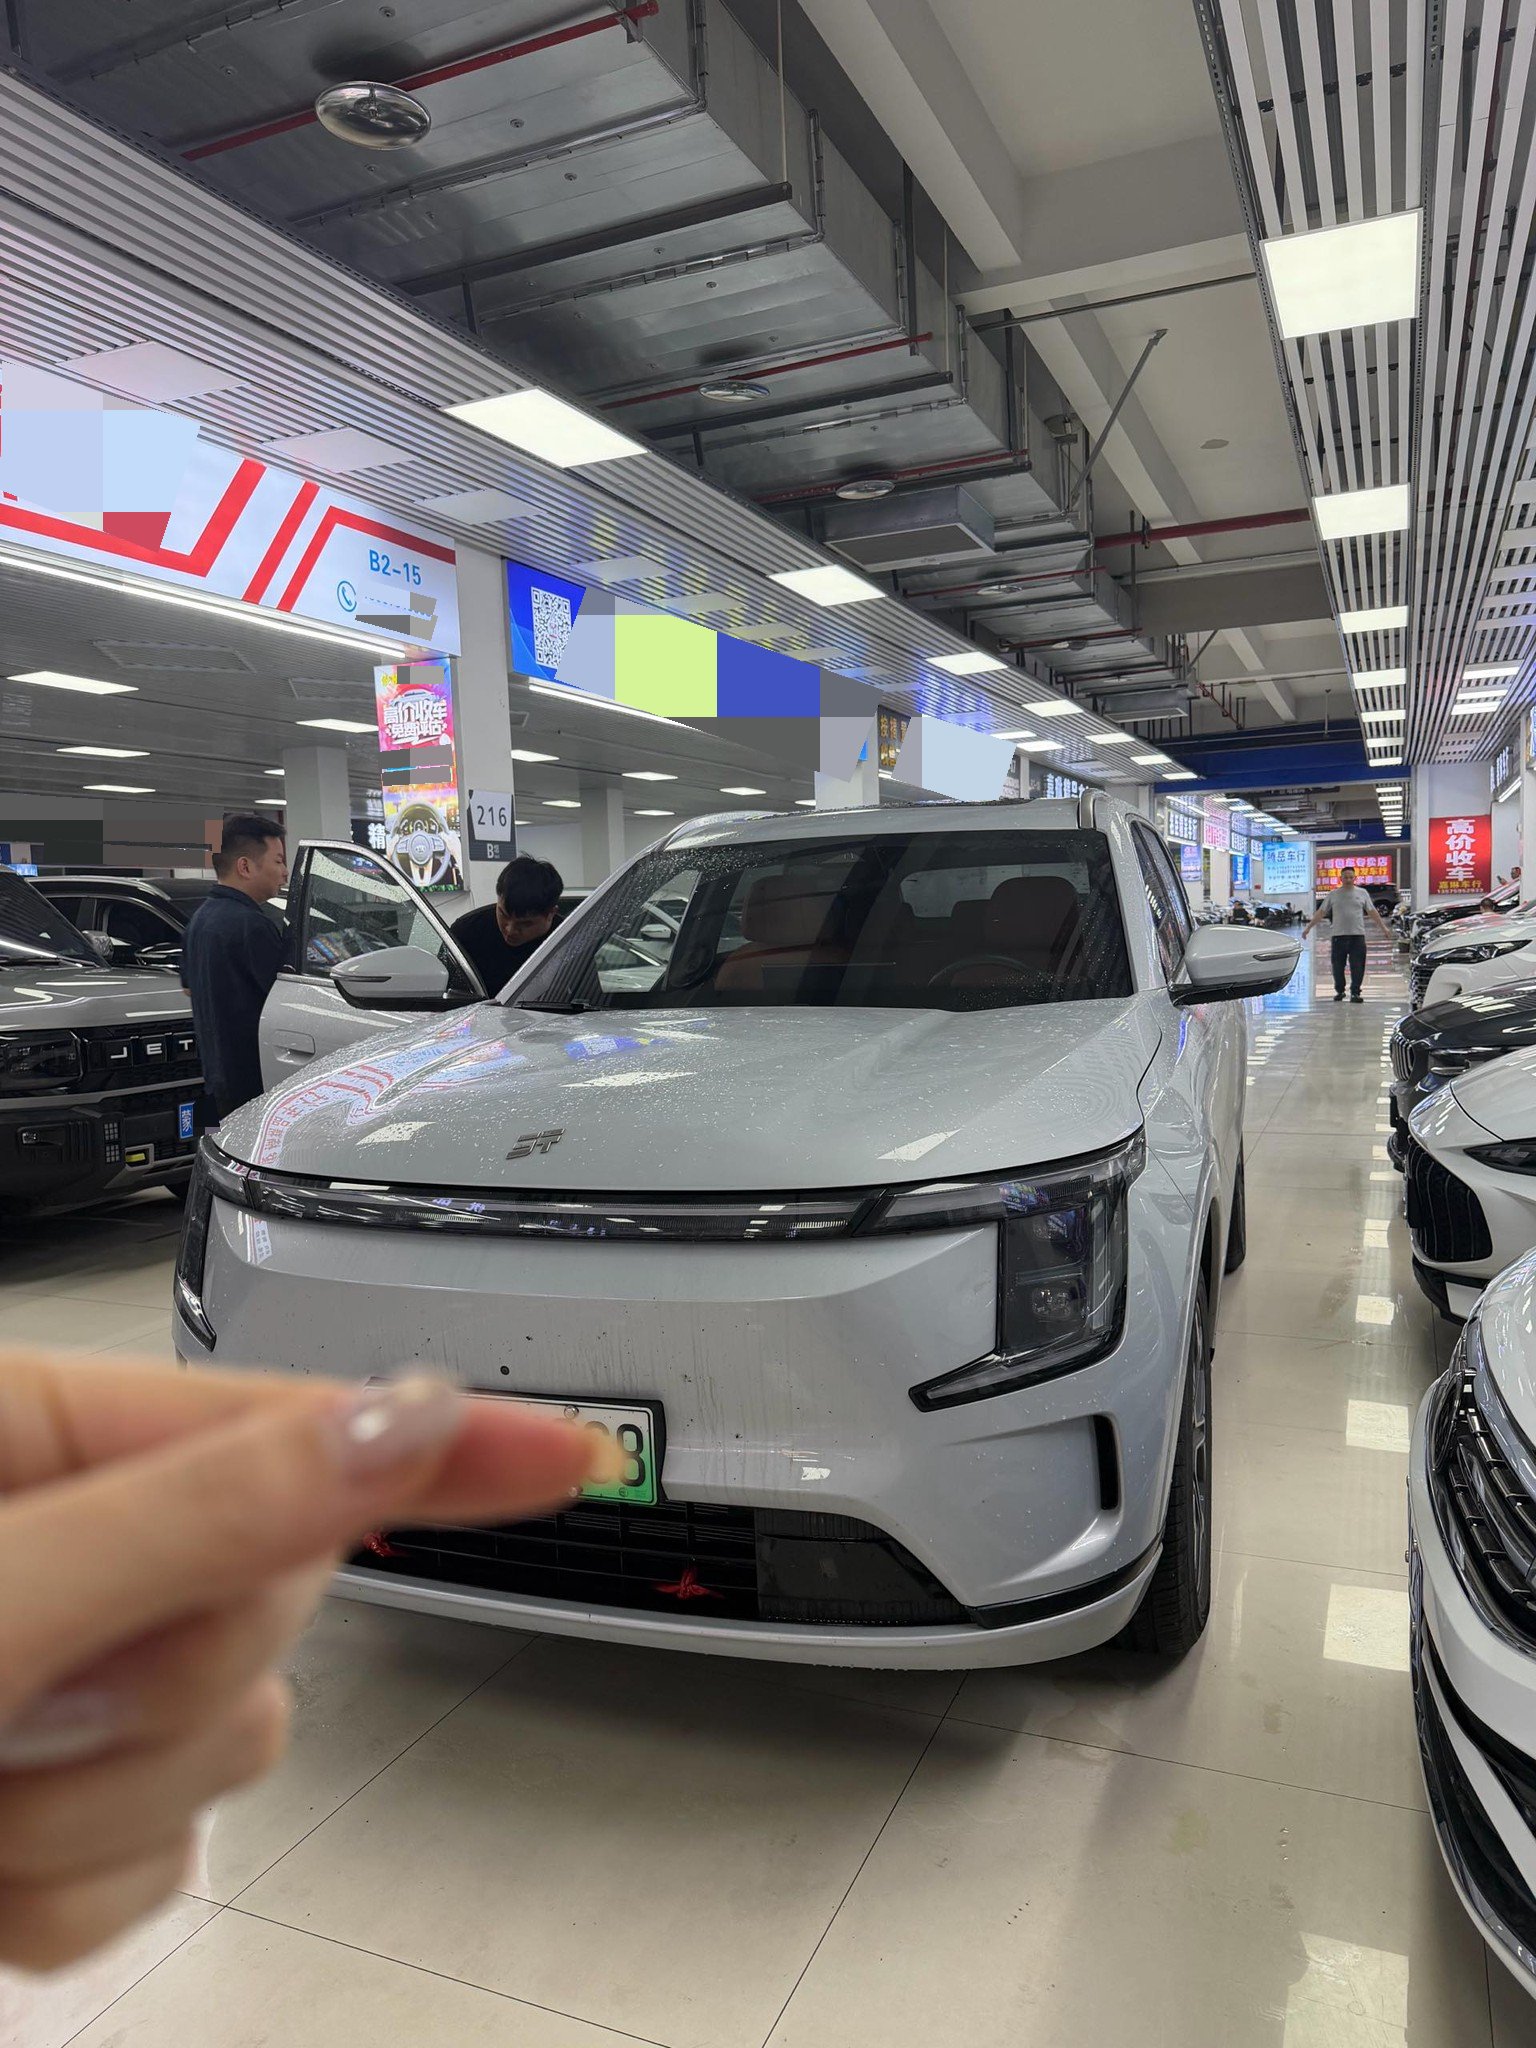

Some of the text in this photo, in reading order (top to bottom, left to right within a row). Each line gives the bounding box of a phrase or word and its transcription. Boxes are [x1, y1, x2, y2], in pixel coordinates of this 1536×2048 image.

[369, 549, 422, 585] B2-15
[383, 699, 448, 724] 高价收车
[391, 719, 443, 738] 免费评估
[476, 805, 507, 827] 216
[1445, 819, 1476, 881] 高价收车
